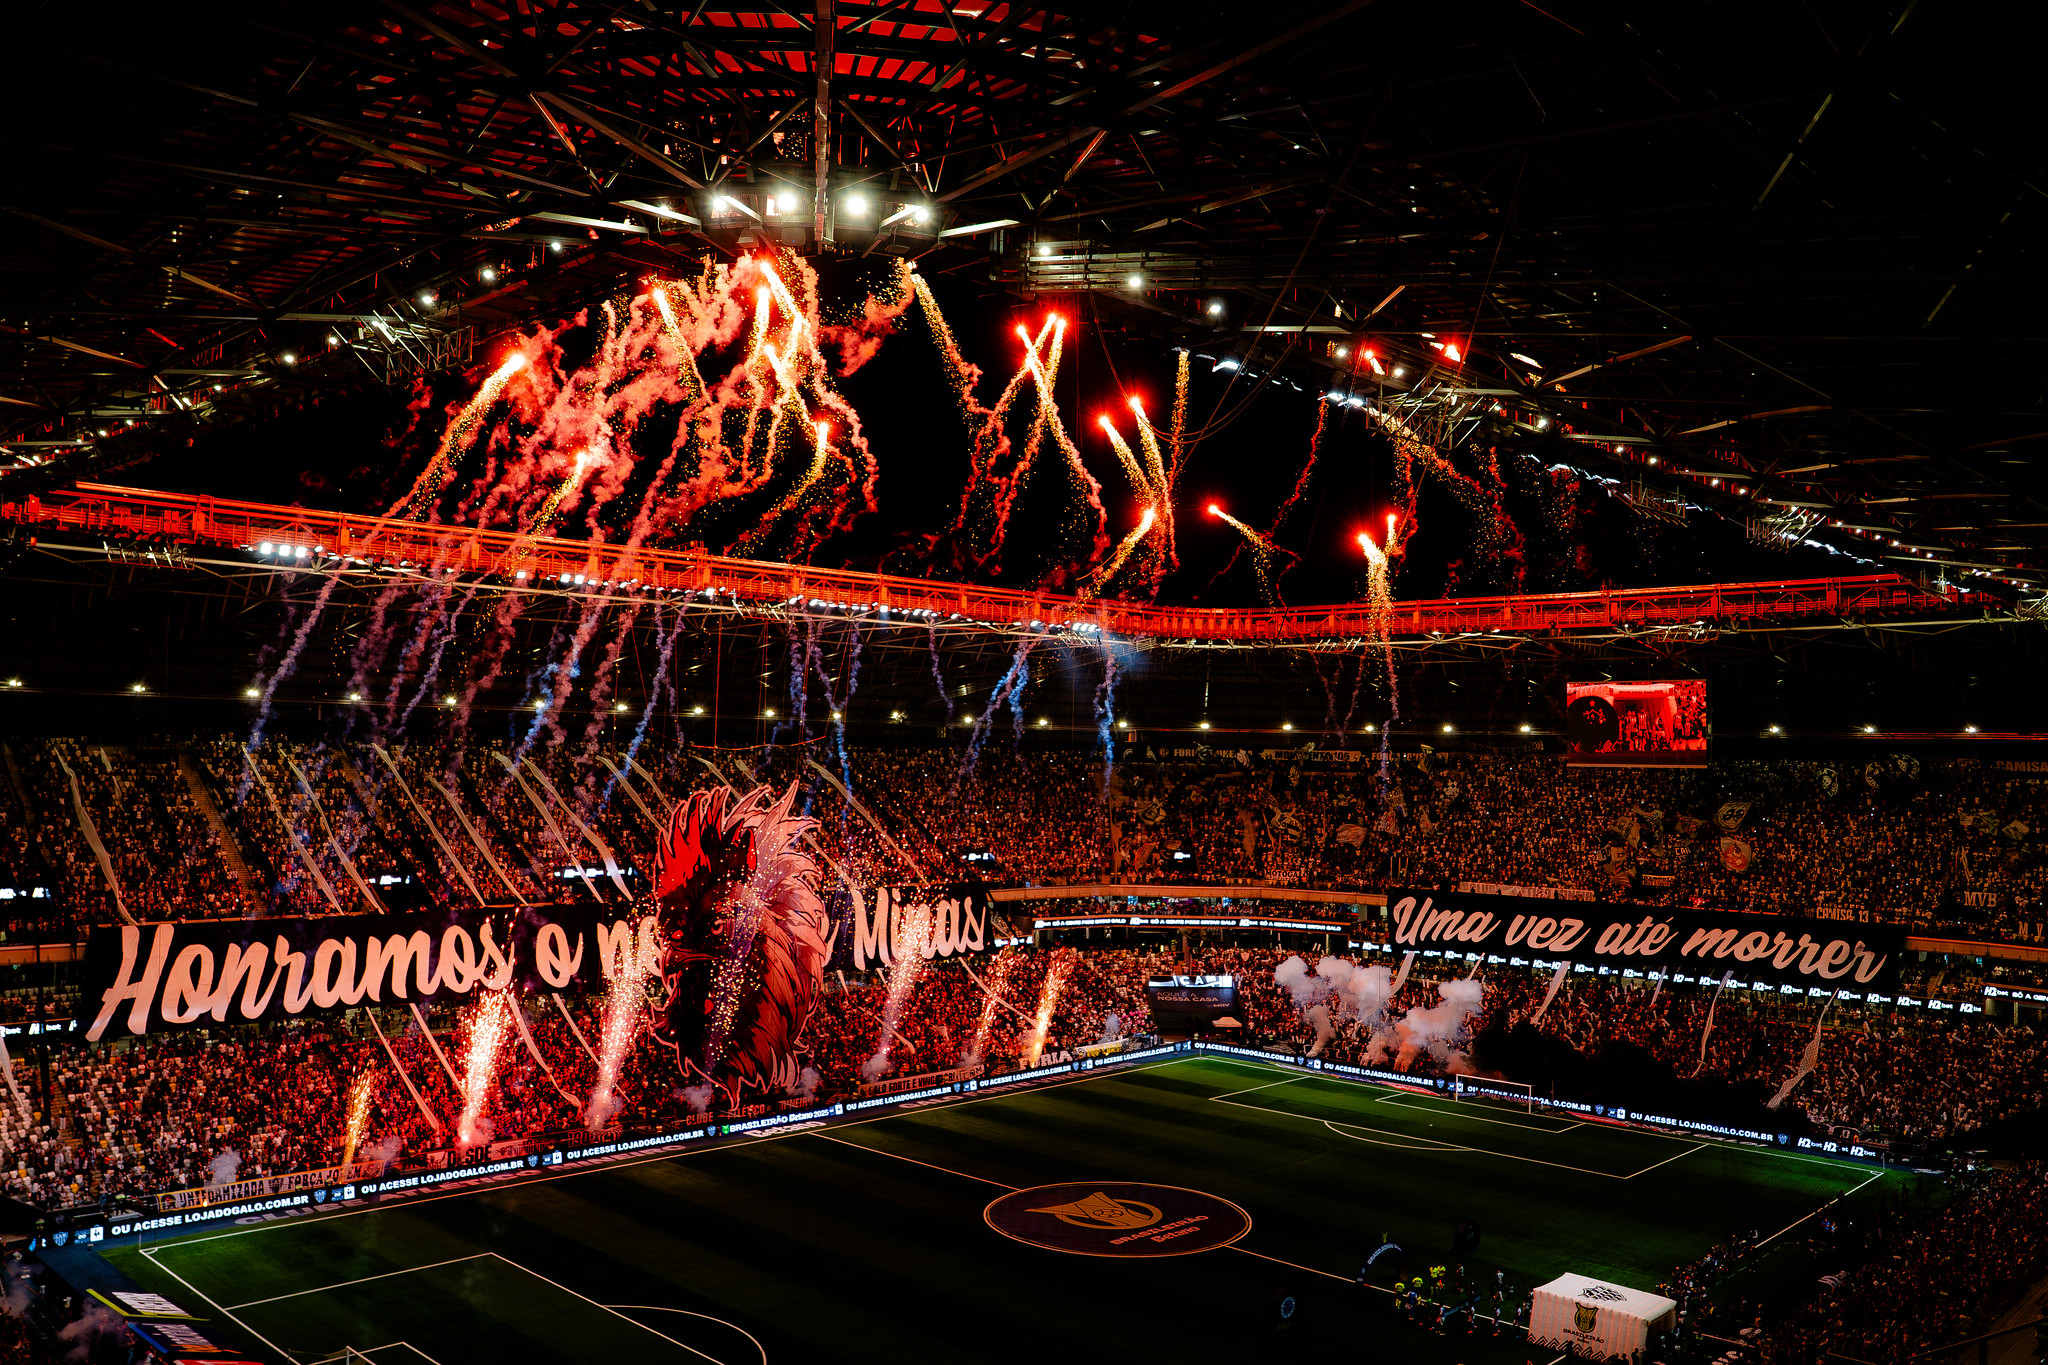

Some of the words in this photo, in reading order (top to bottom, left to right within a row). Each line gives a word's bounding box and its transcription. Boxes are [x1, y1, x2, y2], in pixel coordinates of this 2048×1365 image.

[1963, 891, 1998, 908] MVB
[1858, 910, 1869, 923] 13
[1393, 896, 1502, 947] Uma
[1504, 913, 1592, 953] vez
[1595, 916, 1679, 956] até
[1681, 926, 1888, 983] morrer
[85, 922, 515, 1042] Honramos
[535, 923, 583, 988] o
[1623, 968, 1643, 978] H2bet
[1780, 984, 1803, 994] H2bet
[1808, 987, 1832, 997] H2bet
[1837, 990, 1861, 1000] H2bet
[1867, 993, 1891, 1003] H2bet
[1897, 996, 1922, 1006] H2bet
[1928, 999, 1953, 1010] H2bet
[1984, 986, 2008, 996] H2bet
[1206, 1043, 1230, 1053] ACESSE
[1323, 1062, 1334, 1070] OU
[1335, 1064, 1360, 1075] ACESSE
[1361, 1067, 1434, 1087] LOJADOGALO.COM.BR
[846, 1103, 857, 1111] OU
[857, 1097, 884, 1109] ACESSE
[729, 1115, 788, 1133] BRASILEIRÃO
[813, 1109, 830, 1118] 2025
[1630, 1112, 1642, 1120] OU
[1644, 1114, 1677, 1126] ACESSE
[1678, 1120, 1774, 1142] LOJADOGALO.COM.BR
[567, 1150, 580, 1160] OU
[582, 1143, 617, 1158] ACESSE
[617, 1129, 704, 1152] LOJADOGALO.COM.BR
[1797, 1137, 1823, 1149] H2bet
[1851, 1145, 1876, 1157] H2bet
[361, 1184, 377, 1194] OU
[378, 1177, 419, 1192] ACESSE
[420, 1159, 525, 1184] LOJADOGALO.COM.BR
[111, 1224, 131, 1236] OU
[133, 1216, 182, 1232] ACESSE
[184, 1195, 310, 1223] LOJADOGALO.COM.BR
[1109, 1215, 1210, 1245] BRASILEIRÃO
[1150, 1226, 1201, 1243] Betano
